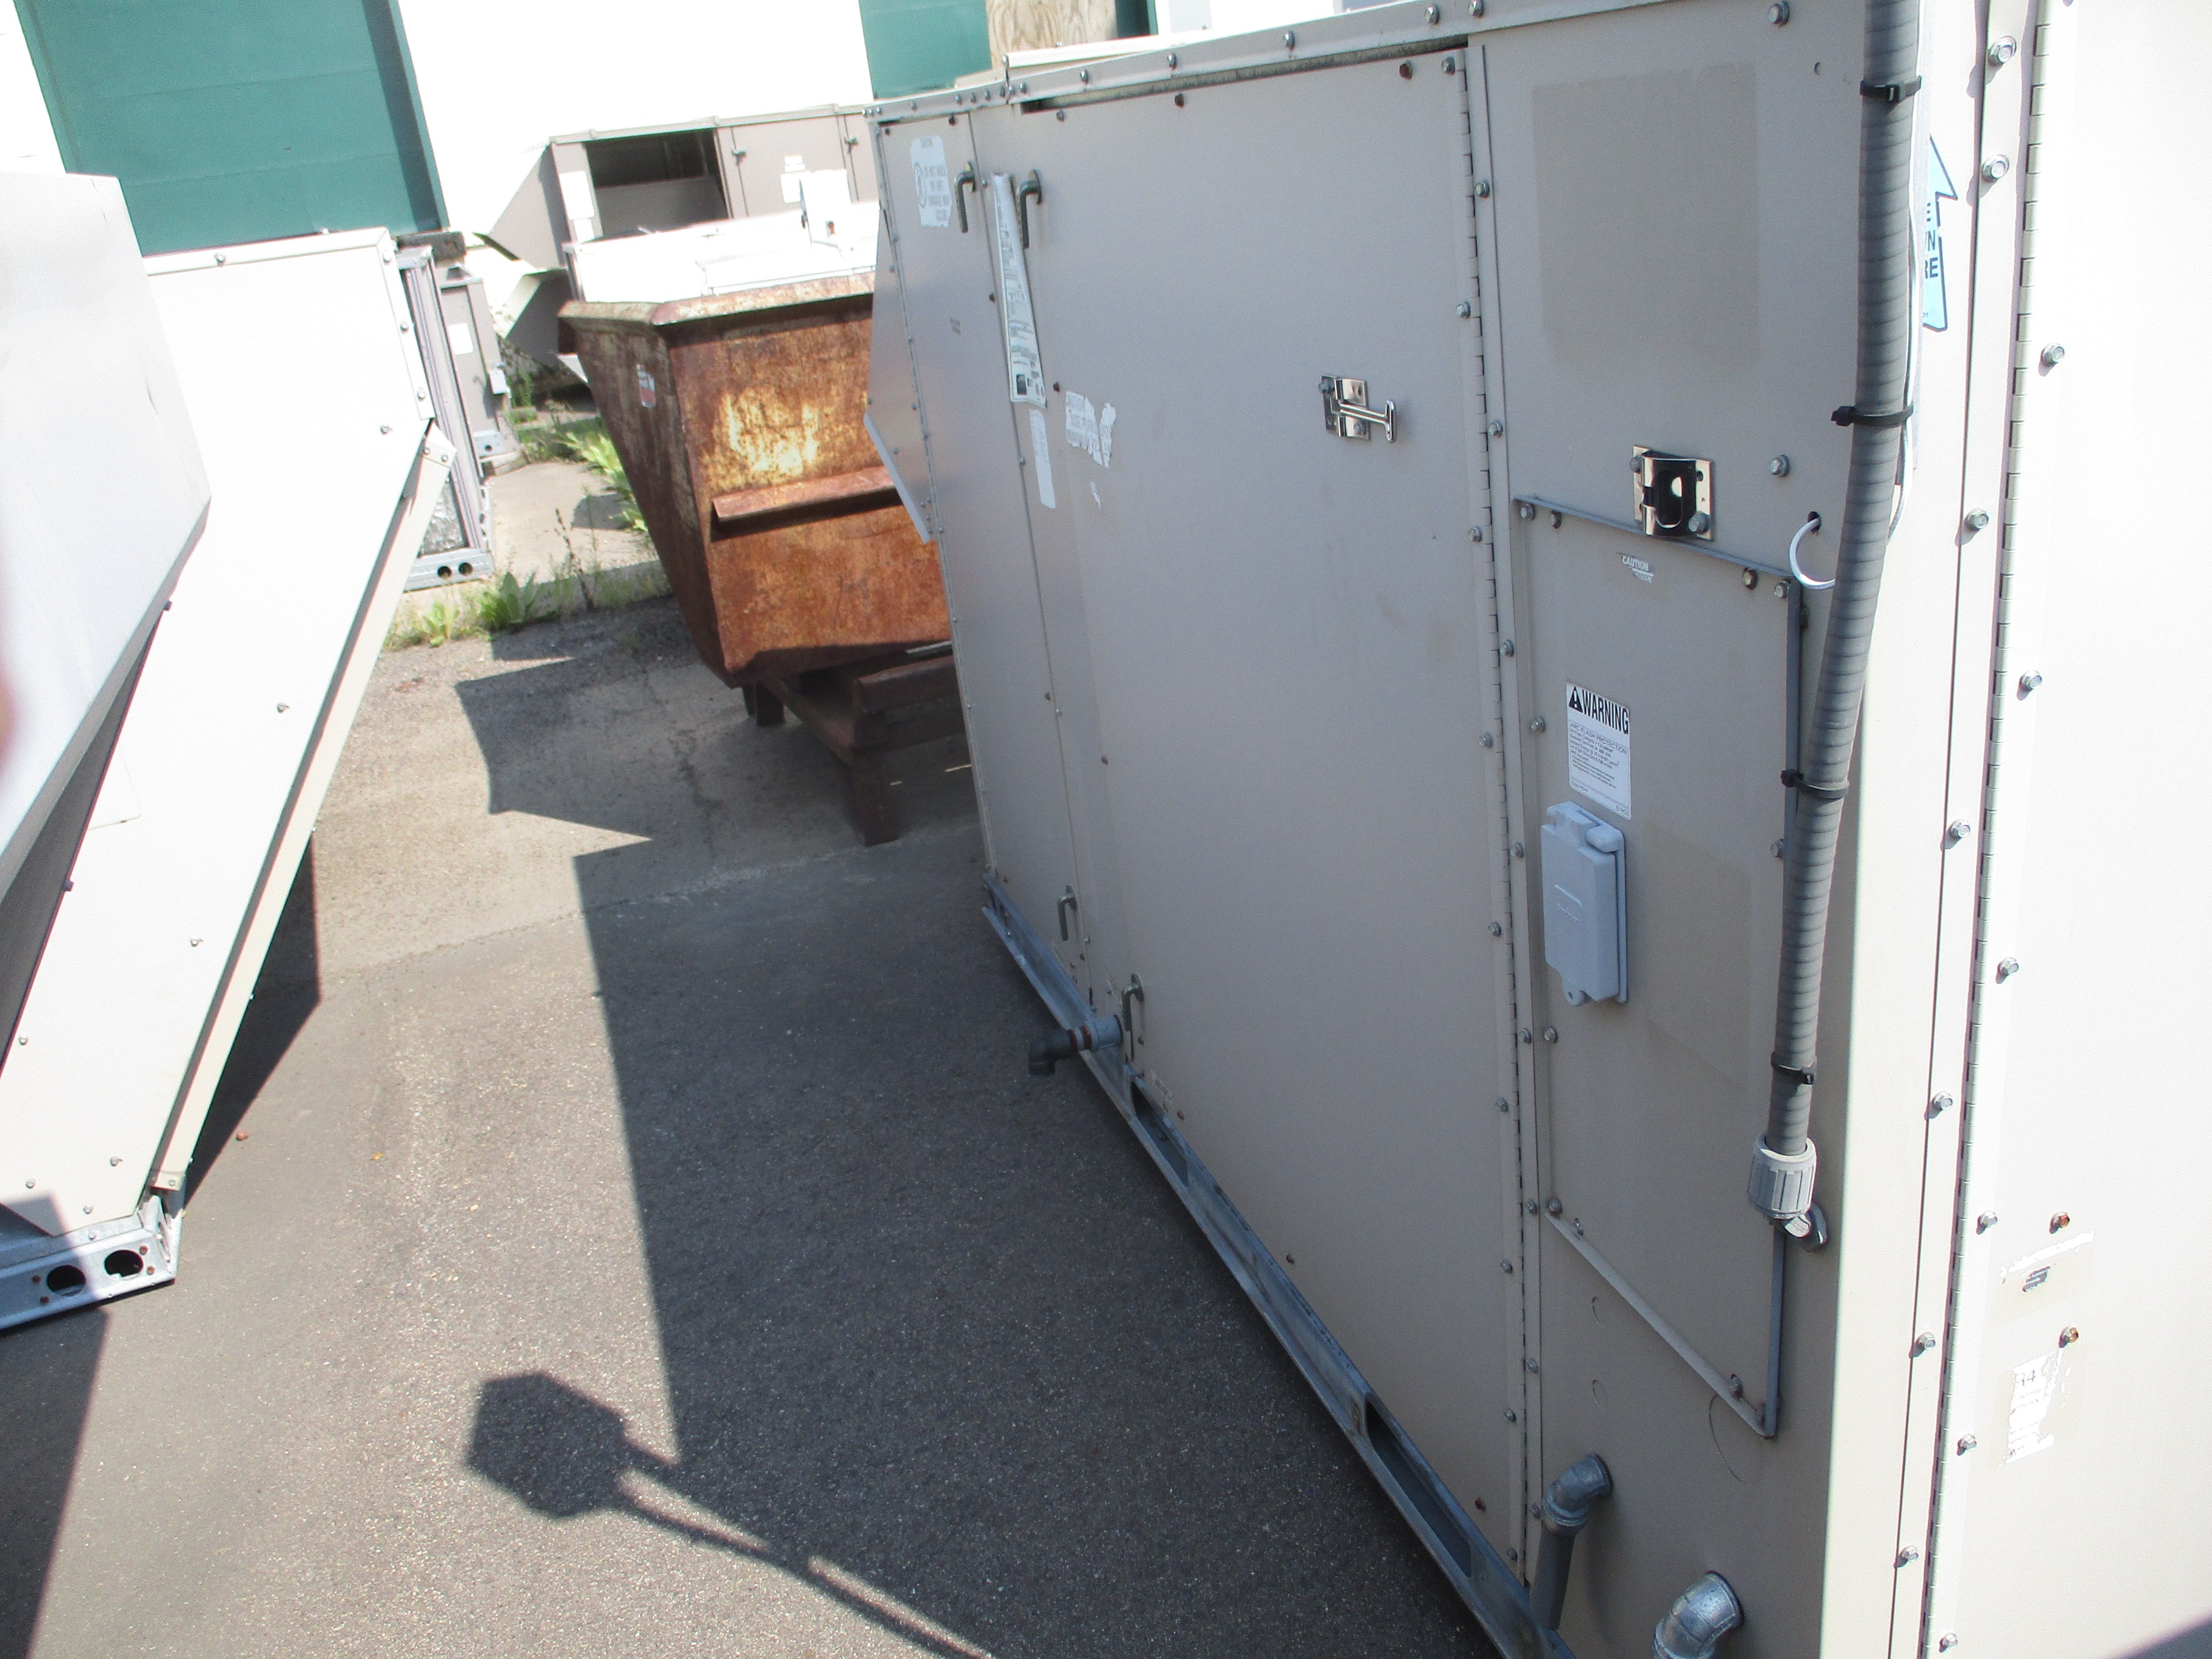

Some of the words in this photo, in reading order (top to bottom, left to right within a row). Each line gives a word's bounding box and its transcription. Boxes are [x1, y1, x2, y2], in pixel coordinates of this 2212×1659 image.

[1622, 555, 1649, 572] CAUTION
[1582, 689, 1629, 735] WARNING
[1570, 722, 1580, 731] ARC
[1581, 727, 1595, 739] FLASH
[1596, 735, 1627, 755] PROTECTION
